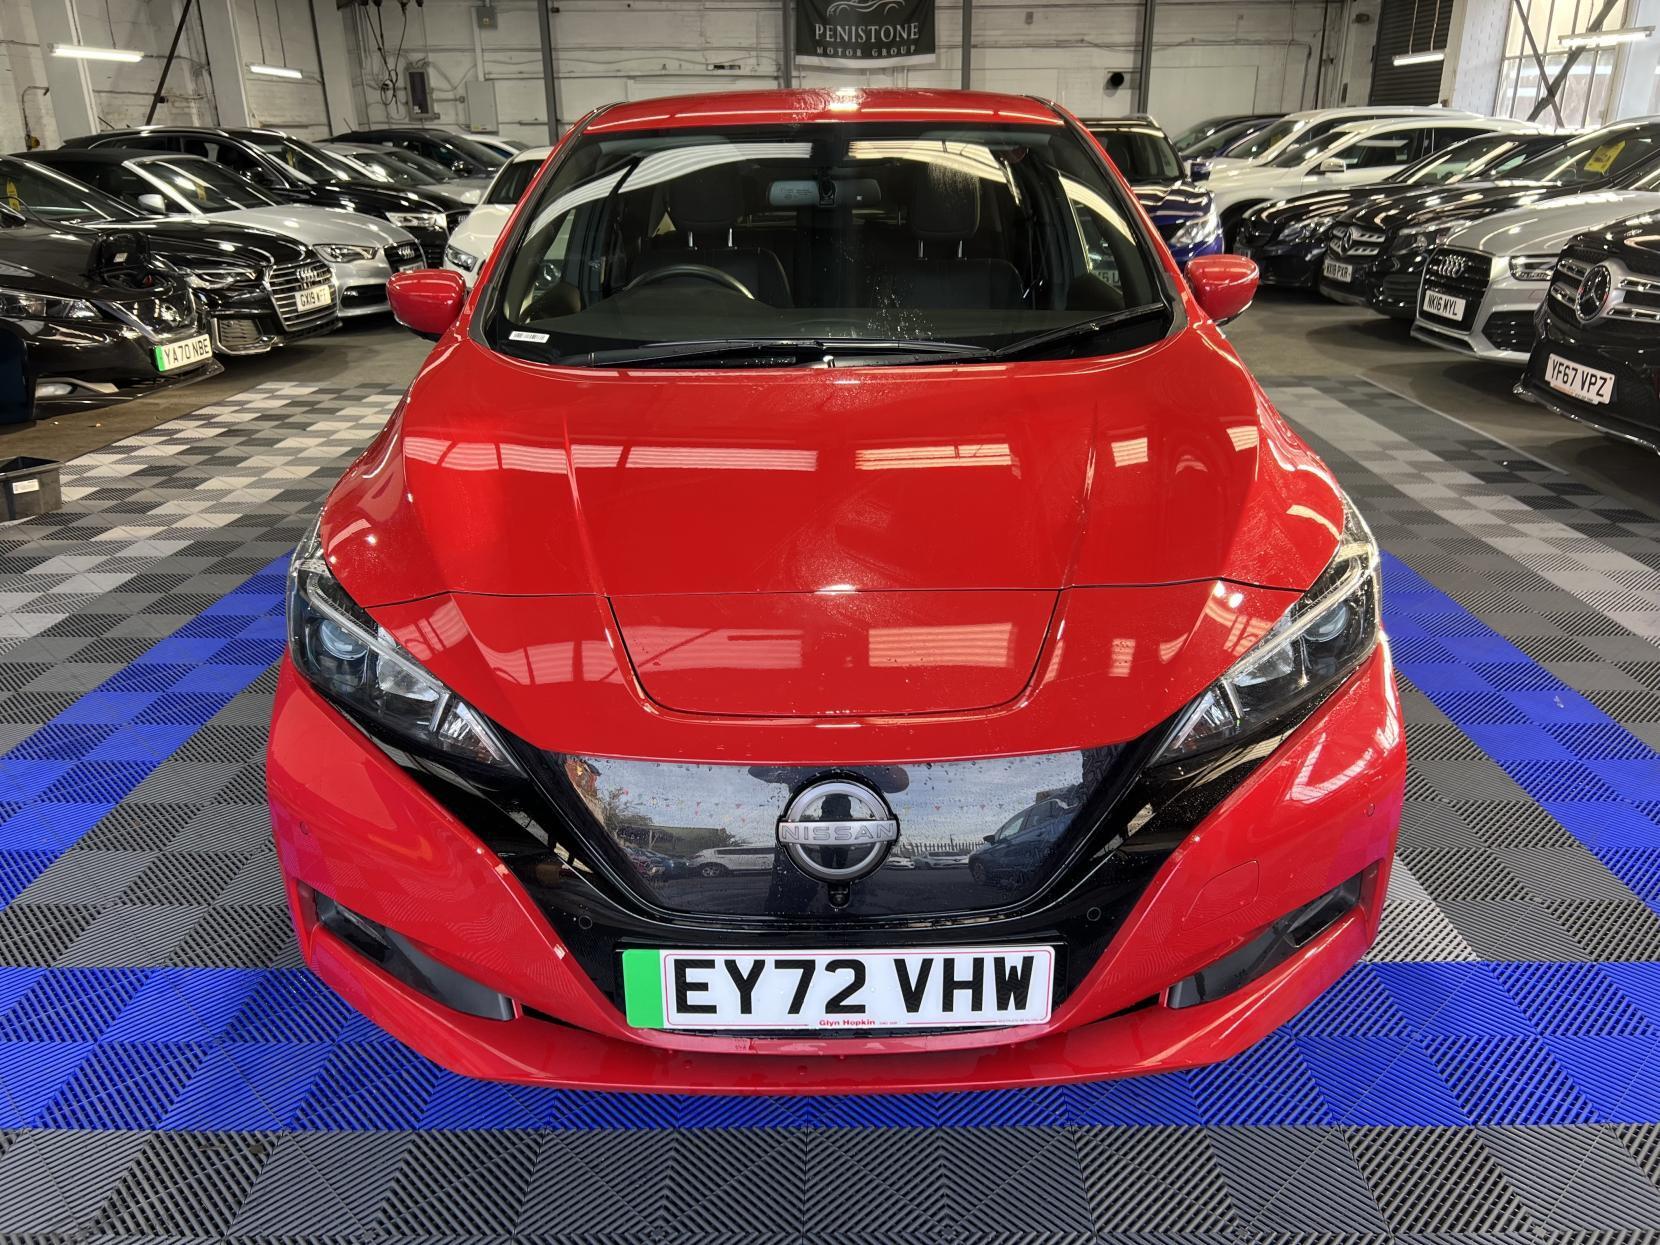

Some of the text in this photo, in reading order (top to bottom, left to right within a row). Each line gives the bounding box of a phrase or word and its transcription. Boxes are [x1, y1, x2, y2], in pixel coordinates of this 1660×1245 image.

[815, 23, 919, 43] PENISTONE
[816, 45, 915, 57] MOTOR GROUP
[300, 291, 316, 307] GX19
[164, 338, 210, 365] YA70 NBE
[1551, 359, 1608, 397] YF67 VPZ
[781, 823, 894, 841] NISSAN
[674, 956, 1034, 1015] EY72 VHW
[819, 1019, 840, 1027] Glyn
